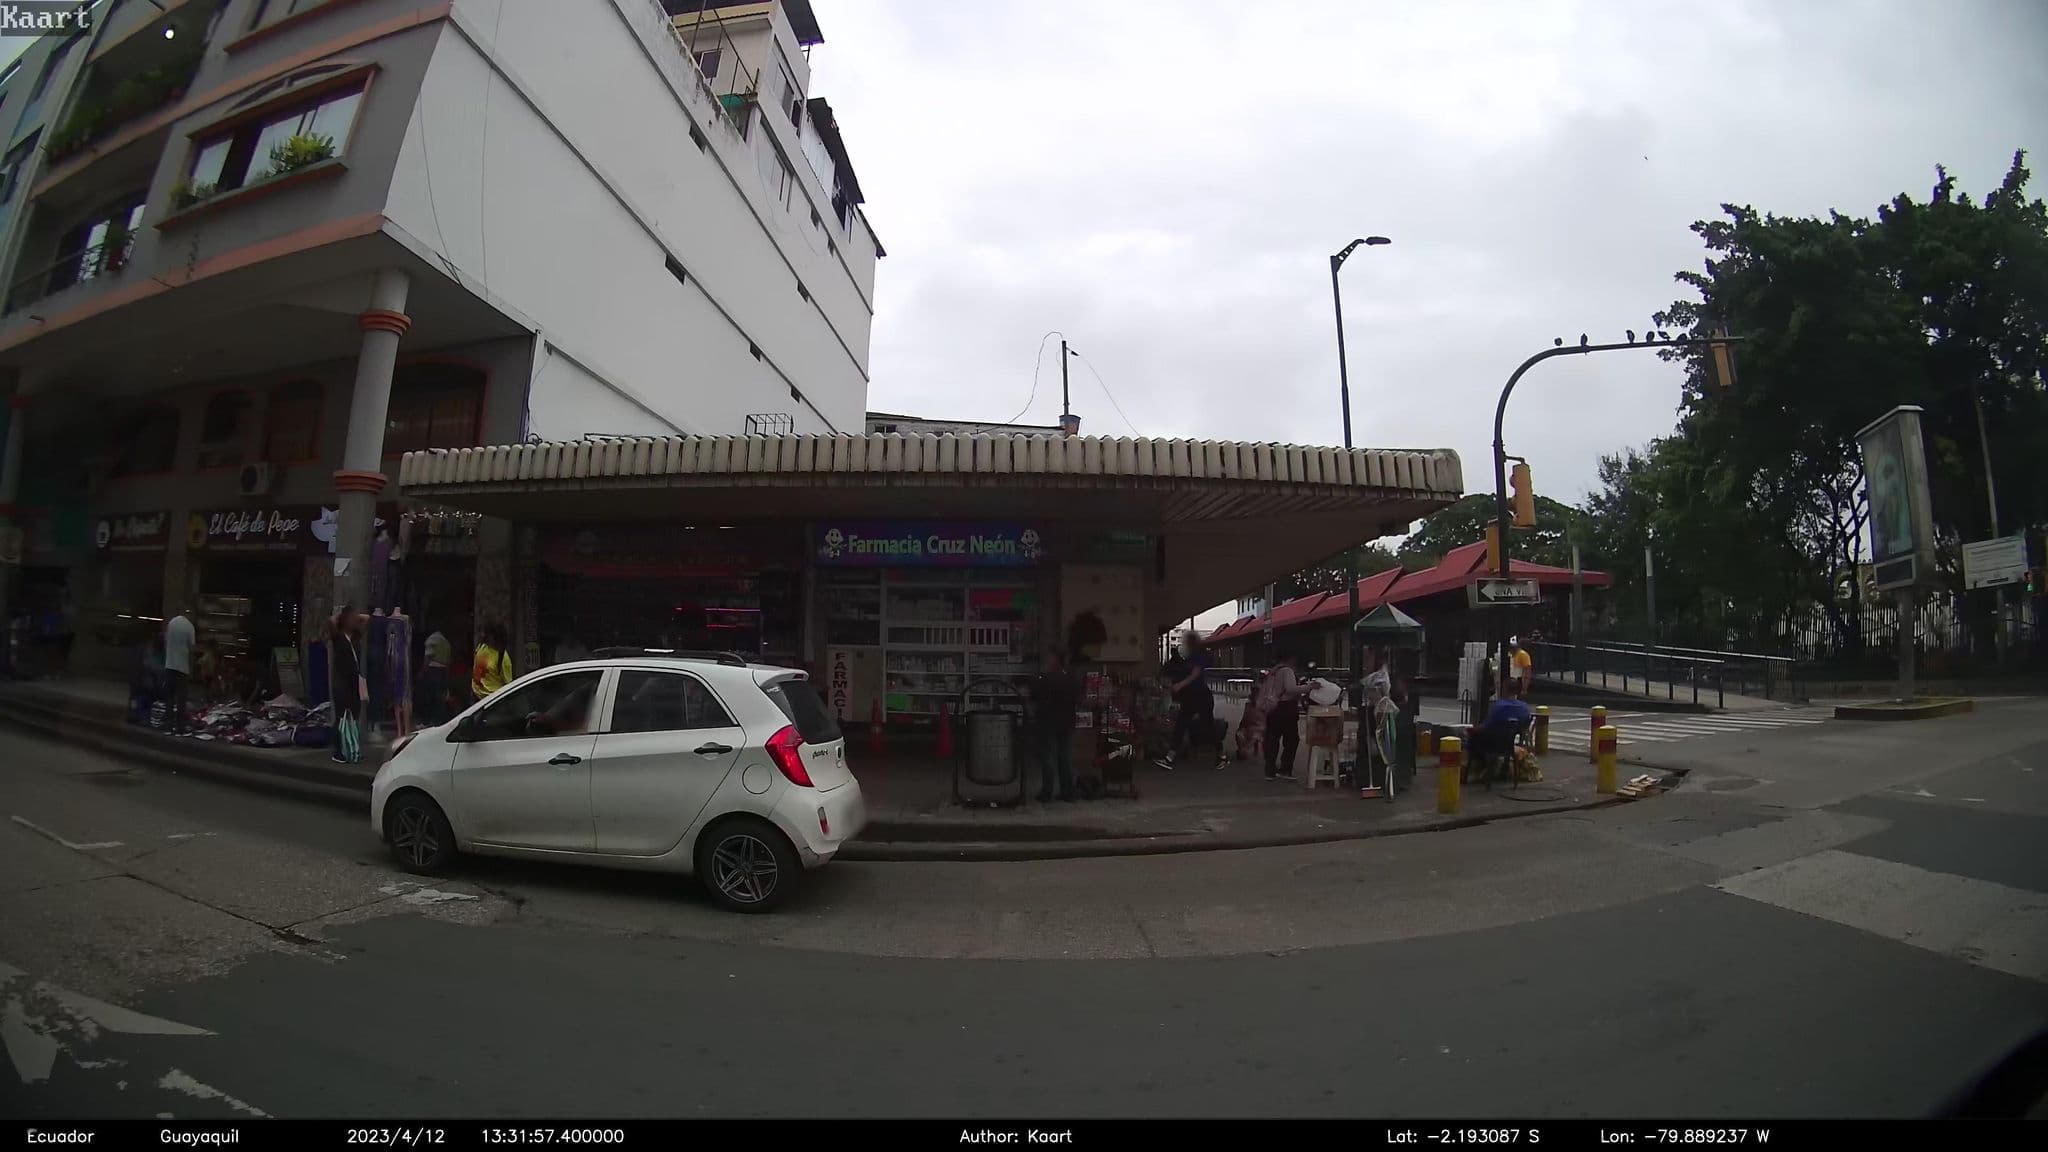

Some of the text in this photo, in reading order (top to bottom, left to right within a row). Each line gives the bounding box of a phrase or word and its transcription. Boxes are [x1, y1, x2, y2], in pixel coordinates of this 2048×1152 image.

[208, 510, 300, 541] El Café de Pepe
[848, 533, 1016, 555] Farmacia Cruz Neón
